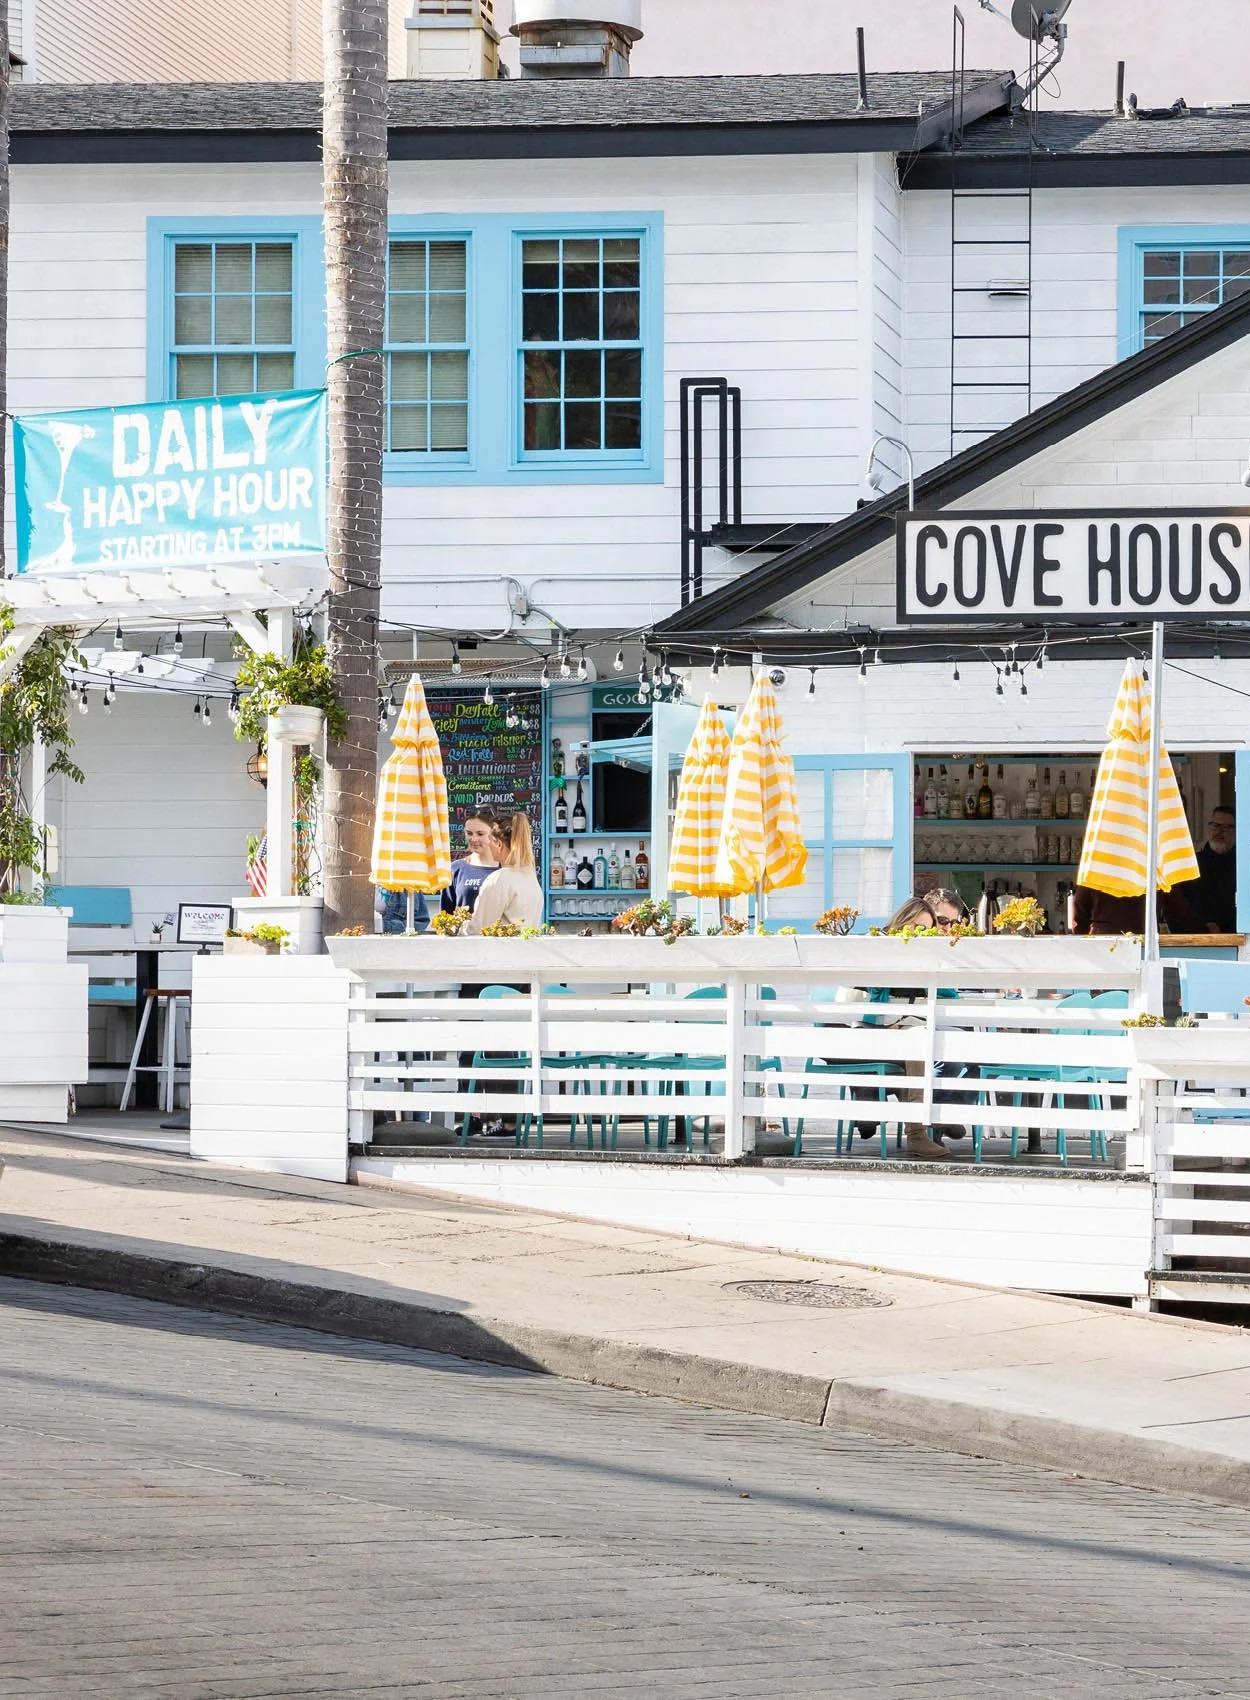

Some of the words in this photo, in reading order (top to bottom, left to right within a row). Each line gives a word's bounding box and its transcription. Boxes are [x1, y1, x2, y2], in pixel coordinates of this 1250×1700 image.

[112, 398, 278, 478] DAILY
[83, 477, 204, 529] HAPPY
[213, 467, 313, 518] HOUR
[99, 530, 207, 562] STARTING
[214, 527, 243, 552] AT
[251, 521, 300, 551] 3PM
[916, 523, 1064, 607] COVE
[448, 793, 474, 804] EYOND
